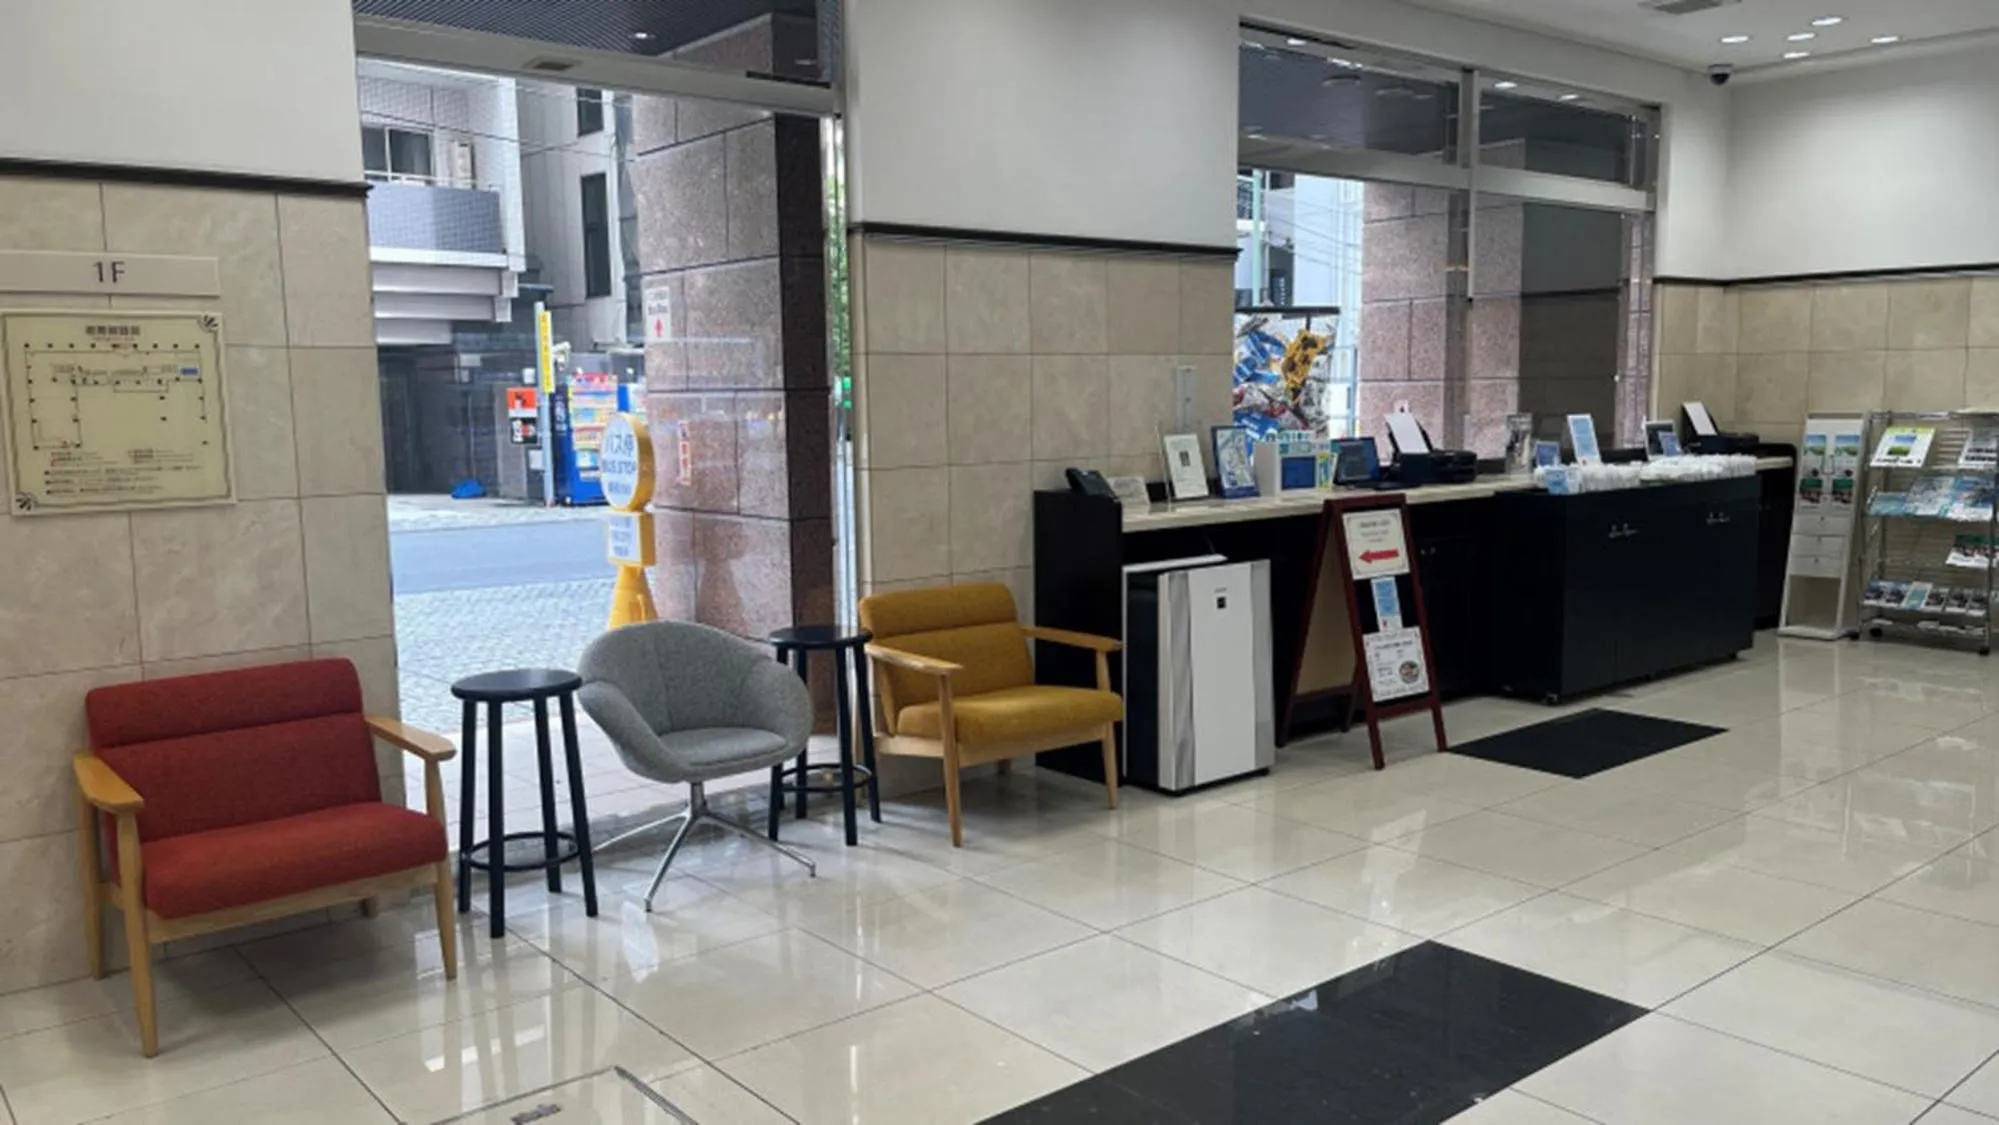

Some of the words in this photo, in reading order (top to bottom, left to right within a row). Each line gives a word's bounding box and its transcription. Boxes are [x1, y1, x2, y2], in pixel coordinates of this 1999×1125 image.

[94, 261, 125, 283] 1F
[605, 434, 634, 457] バス停
[602, 460, 617, 474] BUS
[618, 460, 637, 474] STOP
